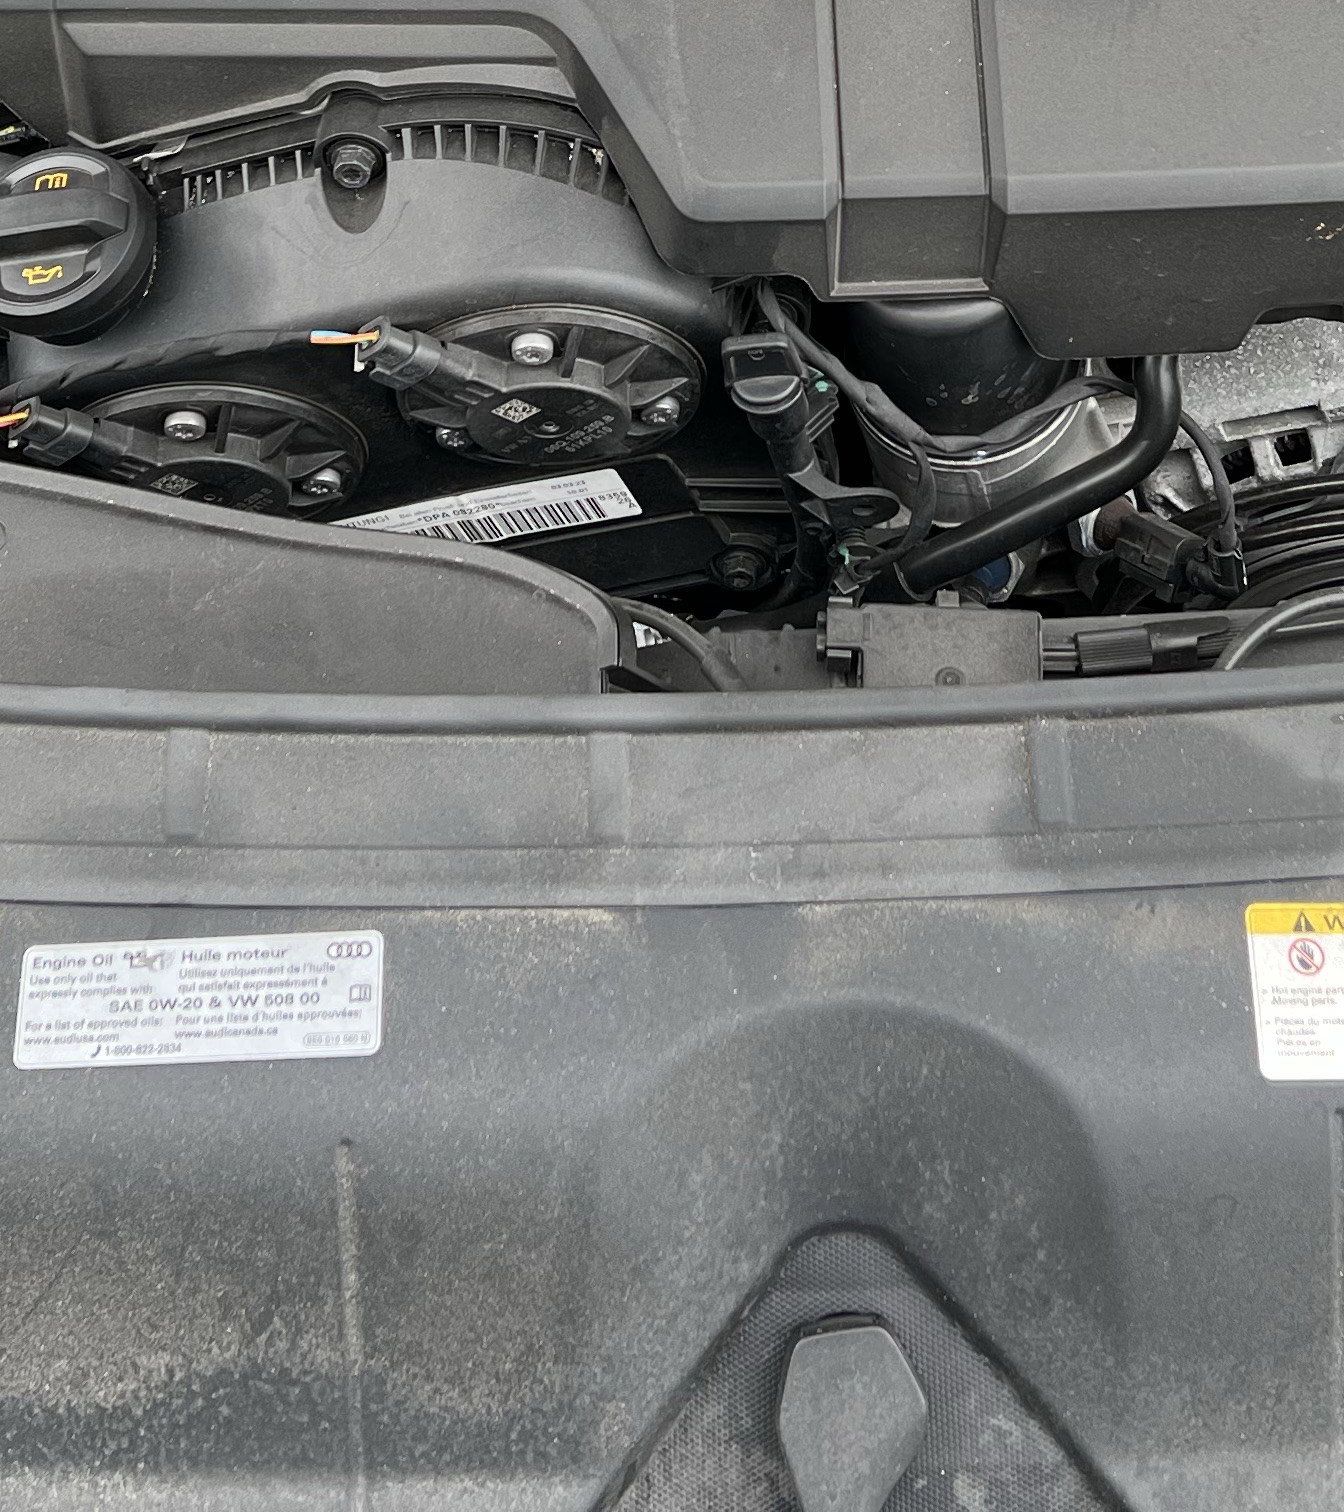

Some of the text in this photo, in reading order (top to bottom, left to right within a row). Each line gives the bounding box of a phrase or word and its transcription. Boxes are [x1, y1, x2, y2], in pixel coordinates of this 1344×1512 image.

[32, 953, 113, 970] Engine Oil
[181, 948, 288, 963] Huile moteur
[220, 966, 284, 979] uniquement
[287, 963, 300, 973] de
[29, 972, 117, 986] Use only oil that
[80, 987, 127, 999] complies
[130, 984, 153, 995] with
[177, 982, 195, 994] qui
[109, 999, 144, 1014] SAE
[149, 995, 203, 1012] 0W-20
[208, 995, 221, 1008] &
[228, 994, 259, 1007] VW
[300, 991, 320, 1005] 00
[24, 1020, 43, 1032] For
[45, 1022, 52, 1030] a
[54, 1019, 71, 1030] list
[73, 1018, 85, 1030] of
[87, 1017, 138, 1031] approved
[175, 1015, 199, 1026] Pour
[203, 1014, 223, 1024] une
[226, 1012, 249, 1023] liste
[23, 1032, 120, 1046] www.audiusa.com
[174, 1026, 278, 1039] www.audicanada.ca
